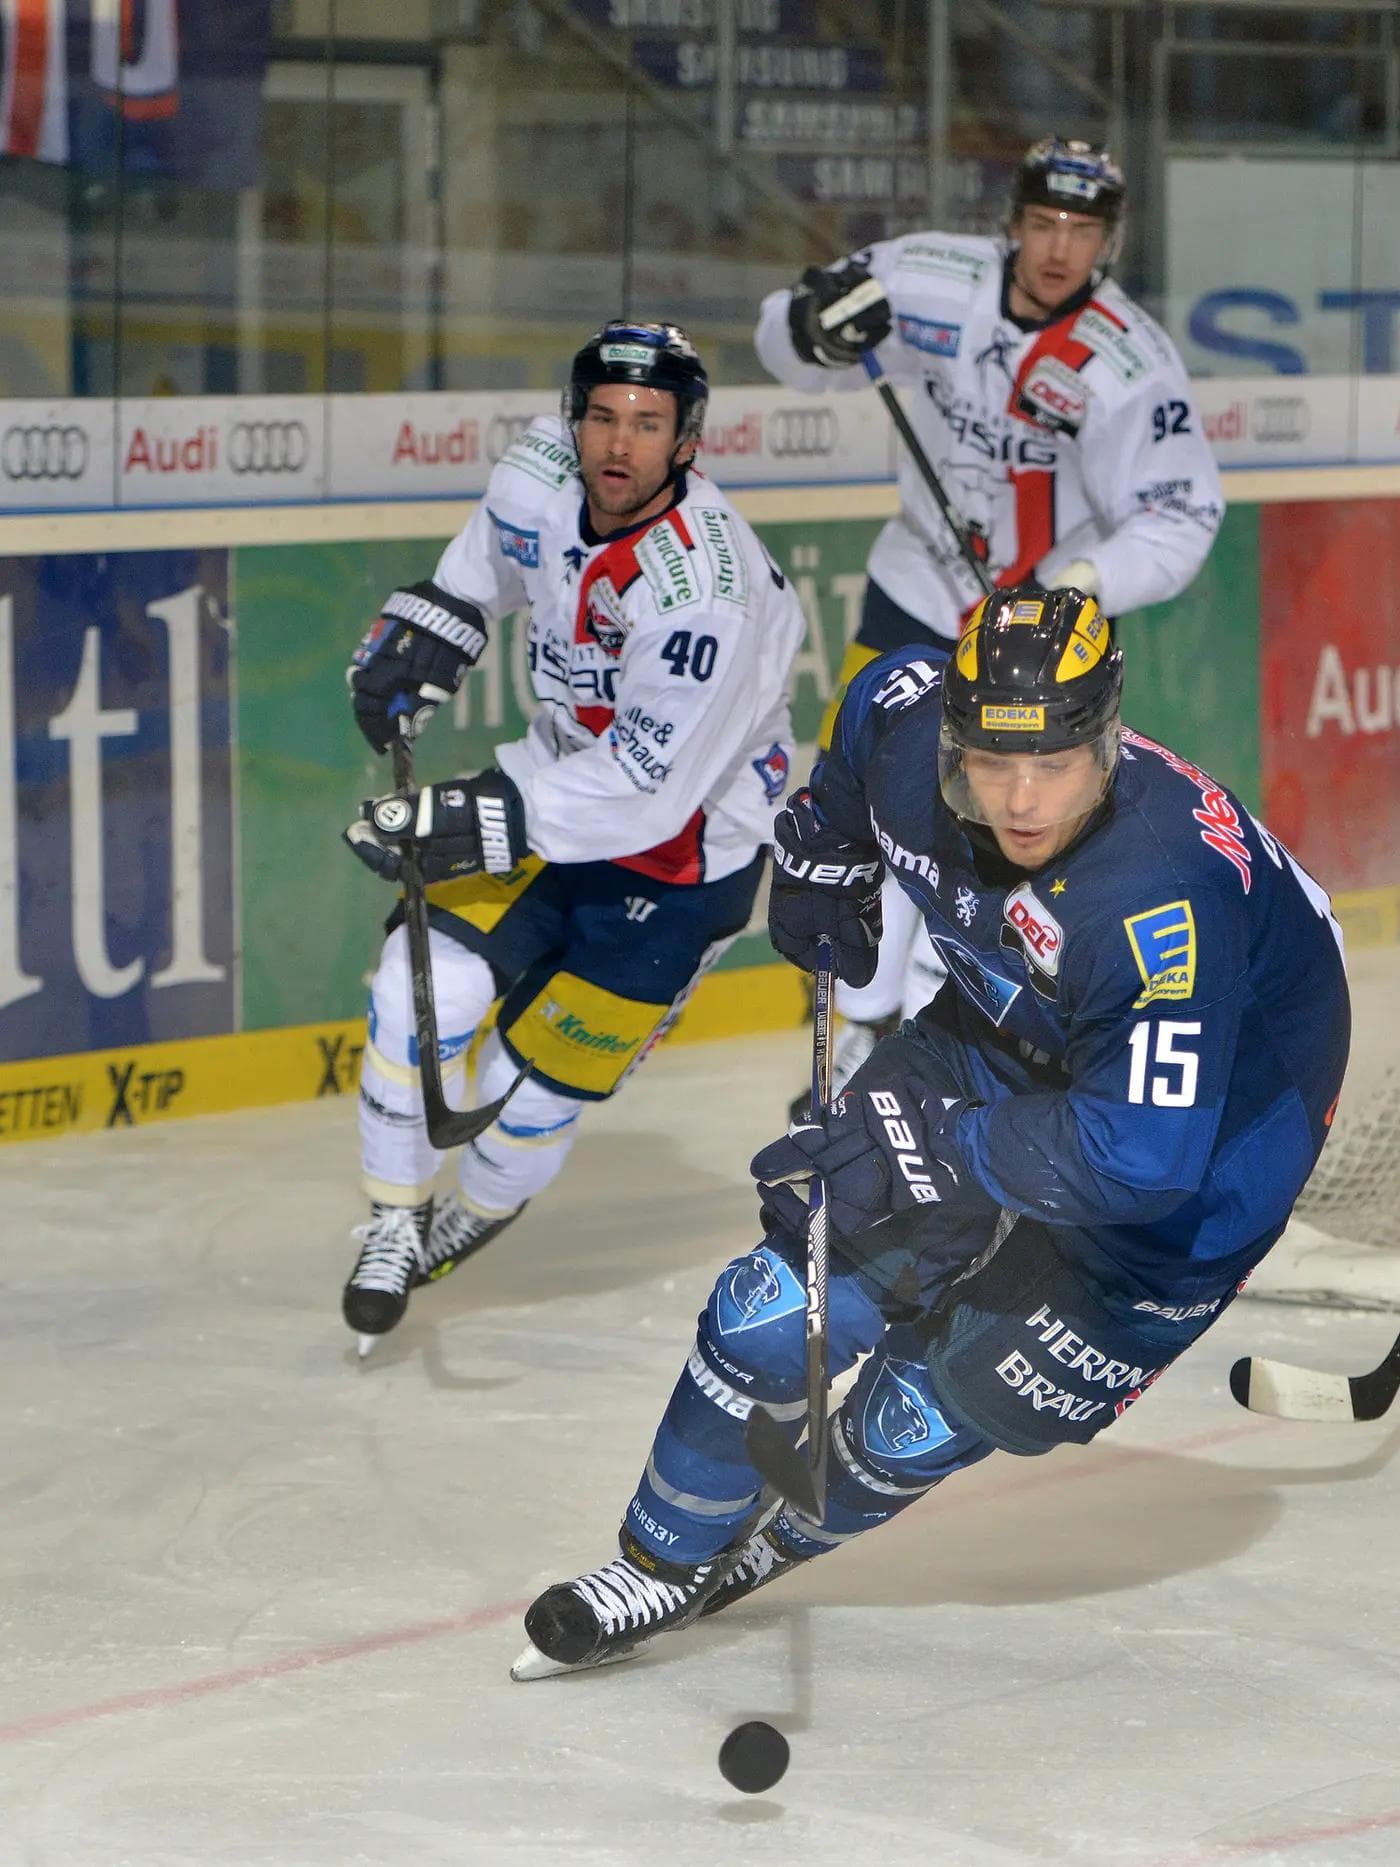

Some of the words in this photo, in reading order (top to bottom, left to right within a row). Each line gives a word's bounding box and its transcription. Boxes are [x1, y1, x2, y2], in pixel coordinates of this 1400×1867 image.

[124, 425, 219, 473] Audi
[392, 420, 480, 465] Audi
[1153, 400, 1192, 443] 92
[1203, 402, 1248, 441] udi
[648, 522, 693, 603] structure
[702, 510, 734, 597] structure
[661, 630, 718, 682] 40
[985, 707, 1040, 721] EDEKA
[1008, 900, 1060, 959] DEL
[1128, 1021, 1201, 1107] 15
[108, 1060, 186, 1128] X-TIP
[995, 1349, 1106, 1422] BRÄU
